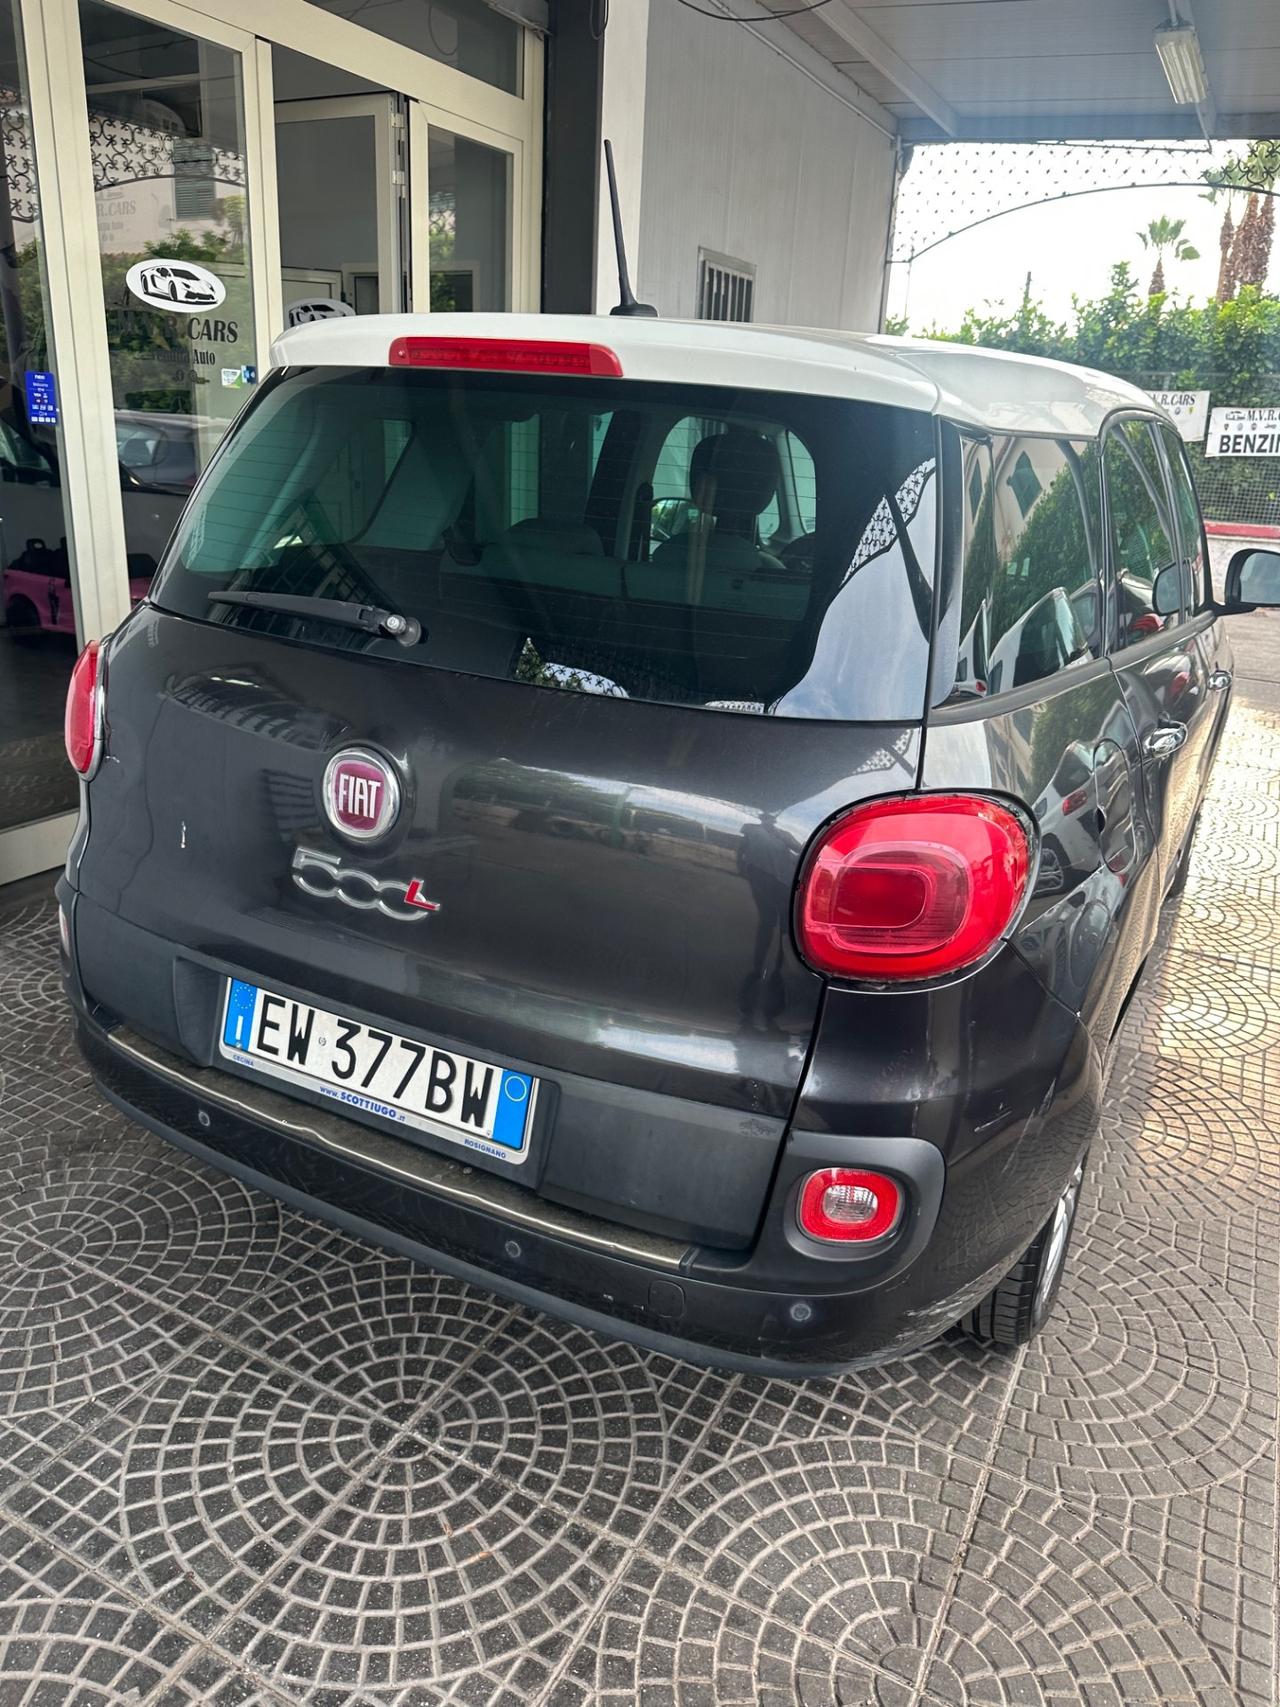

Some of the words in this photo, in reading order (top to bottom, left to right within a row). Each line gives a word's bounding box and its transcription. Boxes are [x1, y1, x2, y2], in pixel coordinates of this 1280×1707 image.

[187, 317, 238, 343] CARS
[192, 349, 216, 365] Auto
[338, 773, 381, 819] FIAT
[292, 847, 440, 921] 500L
[256, 993, 316, 1066] EW
[331, 1018, 495, 1128] 377BW
[464, 1138, 506, 1159] ROSIGNANO
